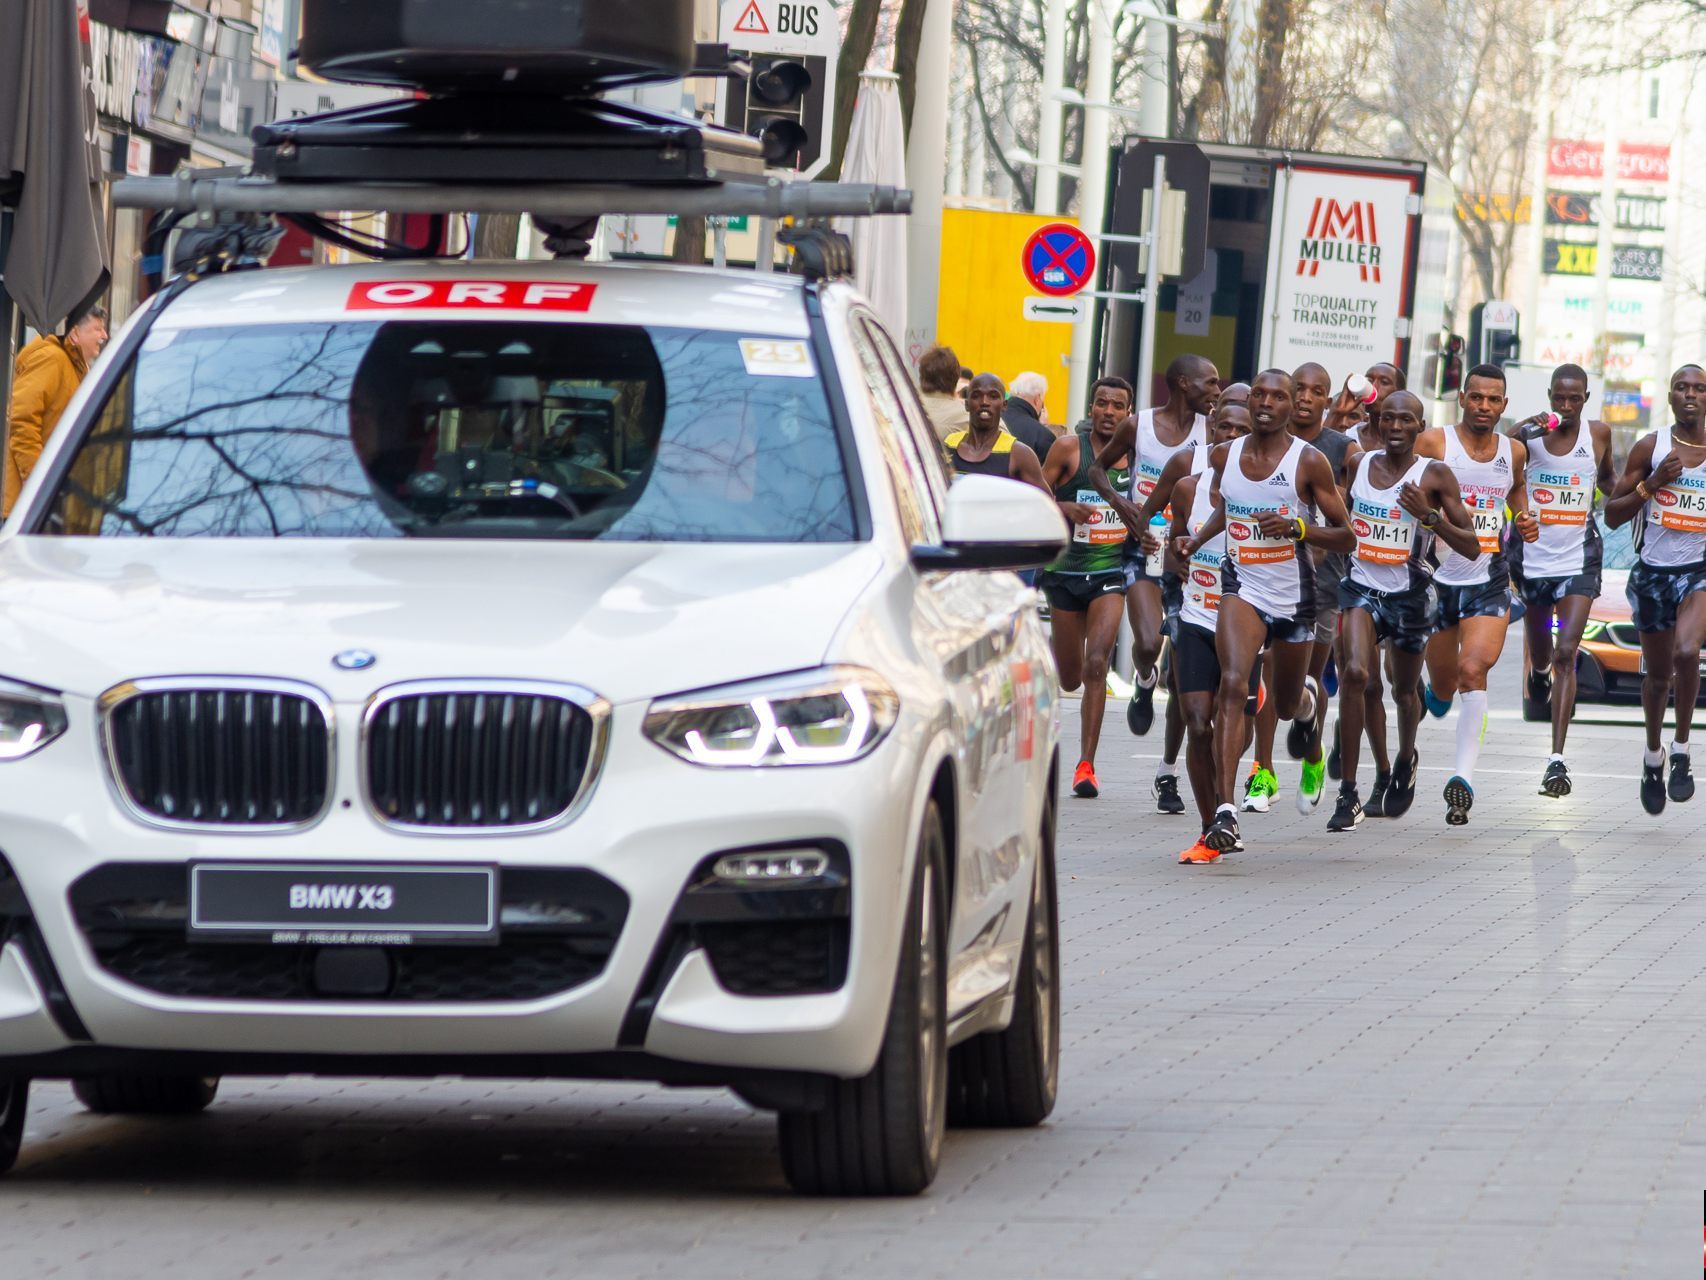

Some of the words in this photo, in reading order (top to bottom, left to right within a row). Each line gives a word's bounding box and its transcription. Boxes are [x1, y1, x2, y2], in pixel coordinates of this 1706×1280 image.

[777, 3, 819, 36] BUS
[1551, 143, 1669, 176] Gergros
[1588, 196, 1666, 227] STUR
[1299, 238, 1381, 266] MÜLLER
[365, 281, 582, 305] ORF
[1294, 293, 1378, 314] TOPQUALITY
[1564, 297, 1643, 314] MEKUR
[1184, 310, 1202, 324] 20
[1292, 309, 1377, 330] TRANSPORT
[1141, 464, 1162, 476] SPAR
[1540, 473, 1569, 486] ERSTE
[1080, 495, 1104, 503] SPAR
[1559, 491, 1584, 506] M-7
[1679, 494, 1706, 511] M-5
[1105, 510, 1122, 524] M-
[1358, 502, 1388, 518] ERSTE
[1475, 515, 1498, 531] M-3
[1372, 524, 1409, 543] M-11
[1261, 549, 1292, 559] ENERGIE
[289, 884, 356, 910] BMW
[357, 884, 394, 910] X3
